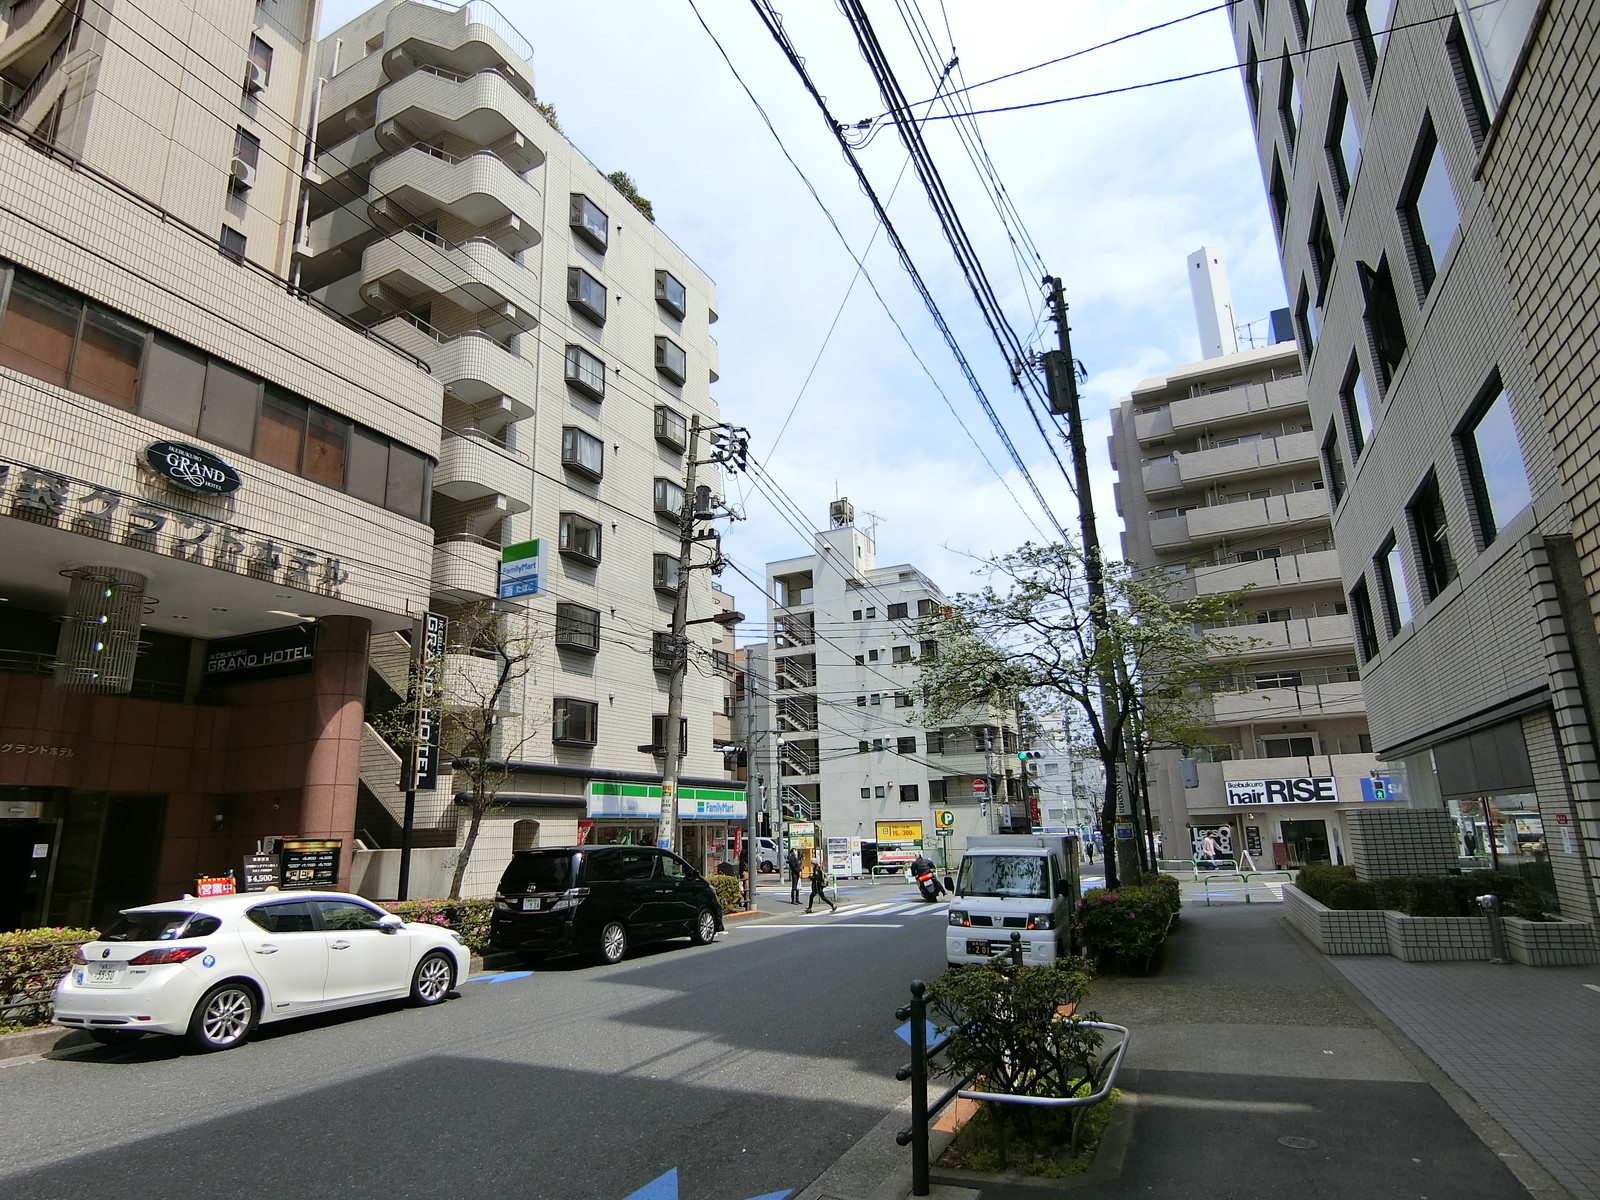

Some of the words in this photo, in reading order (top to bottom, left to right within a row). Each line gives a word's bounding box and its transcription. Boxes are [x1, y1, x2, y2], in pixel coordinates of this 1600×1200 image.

[168, 446, 202, 462] IKEBUKURO
[166, 453, 225, 483] GRAND
[205, 481, 222, 490] HOTEL
[503, 561, 536, 574] FamilyMart
[207, 655, 257, 672] GRAND
[263, 646, 311, 664] HOTEL
[1, 743, 74, 758] グランドホテル
[416, 707, 431, 786] HOTEL
[1228, 790, 1264, 804] hair
[1264, 778, 1336, 803] RISE
[706, 802, 734, 814] FamilyMart
[944, 812, 954, 824] P
[201, 883, 233, 895] 営業中
